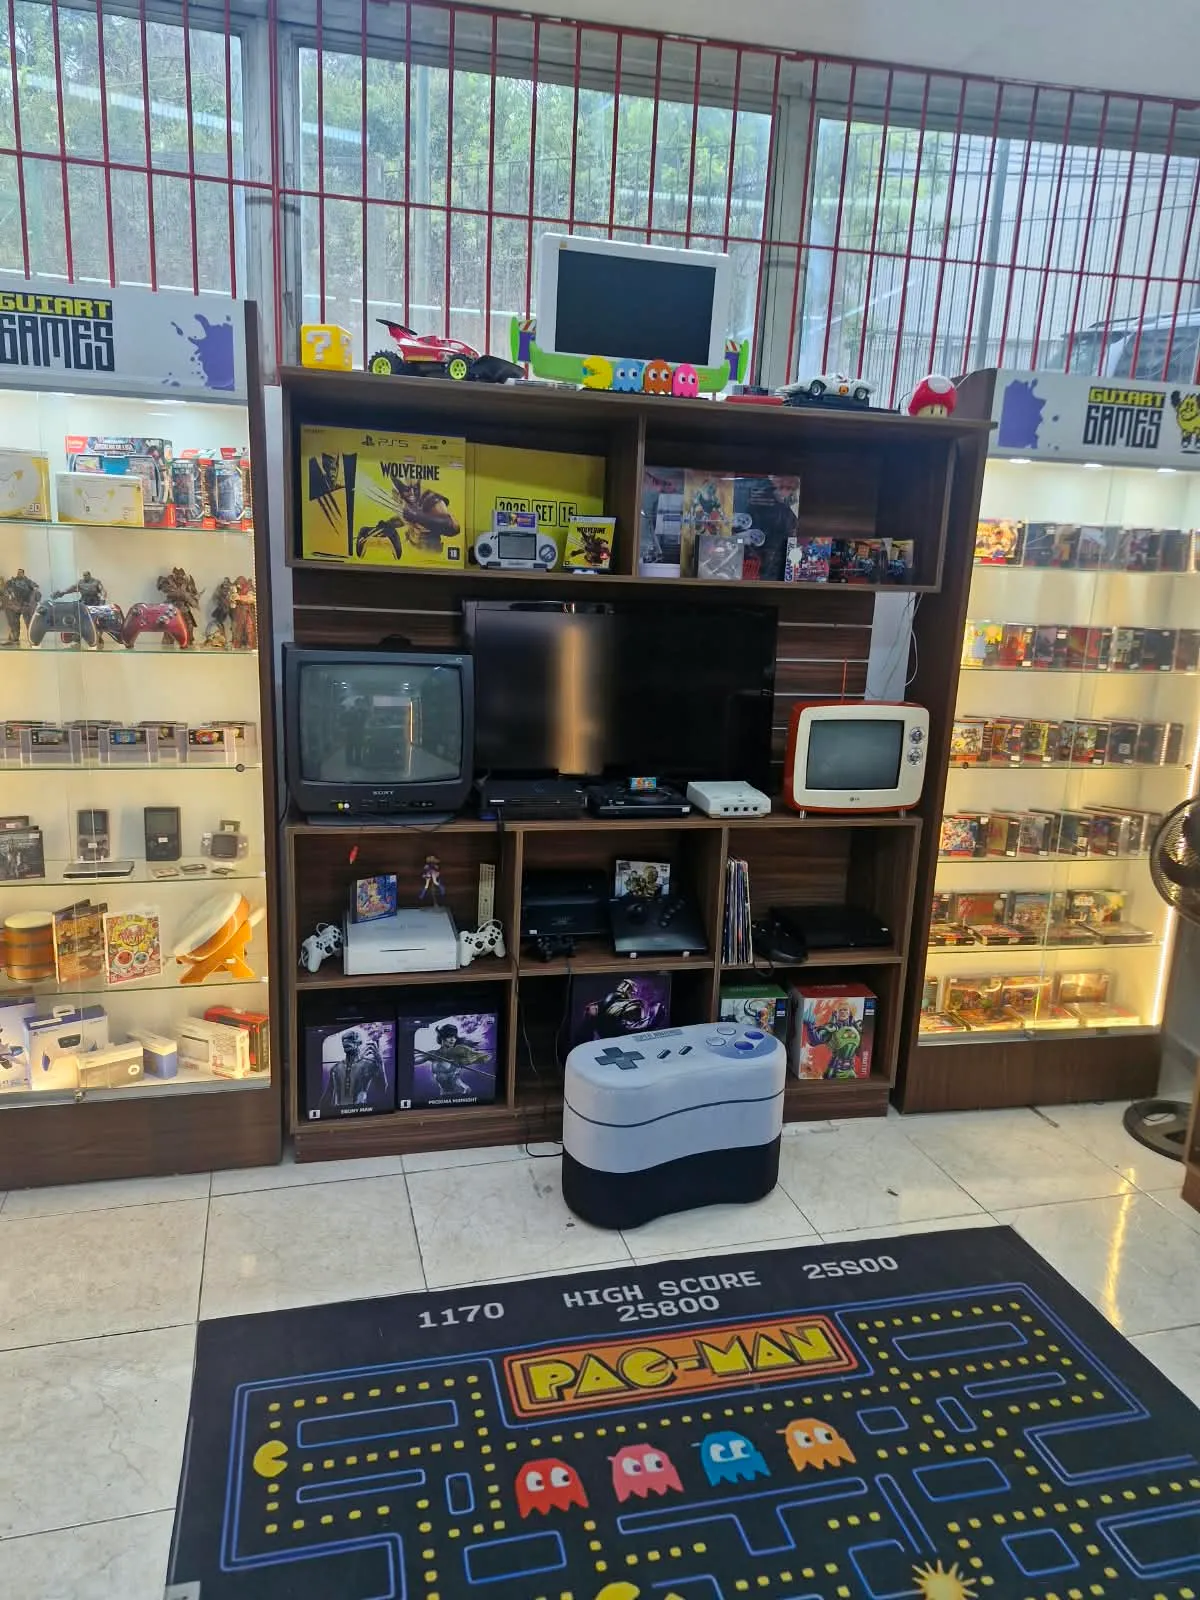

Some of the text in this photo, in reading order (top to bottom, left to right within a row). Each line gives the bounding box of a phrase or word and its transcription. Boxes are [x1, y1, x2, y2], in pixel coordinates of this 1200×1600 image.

[0, 293, 111, 318] GUIART
[0, 314, 115, 372] GAMES
[1090, 388, 1165, 408] GUIART
[1083, 405, 1163, 449] GAMES
[378, 438, 409, 448] PS5
[380, 461, 440, 481] WOLVERINE
[535, 504, 554, 522] SET
[562, 1270, 762, 1308] HIGH SCORE
[418, 1302, 505, 1329] 1170
[616, 1294, 720, 1323] 25800
[521, 1326, 840, 1405] PAC-MAN
